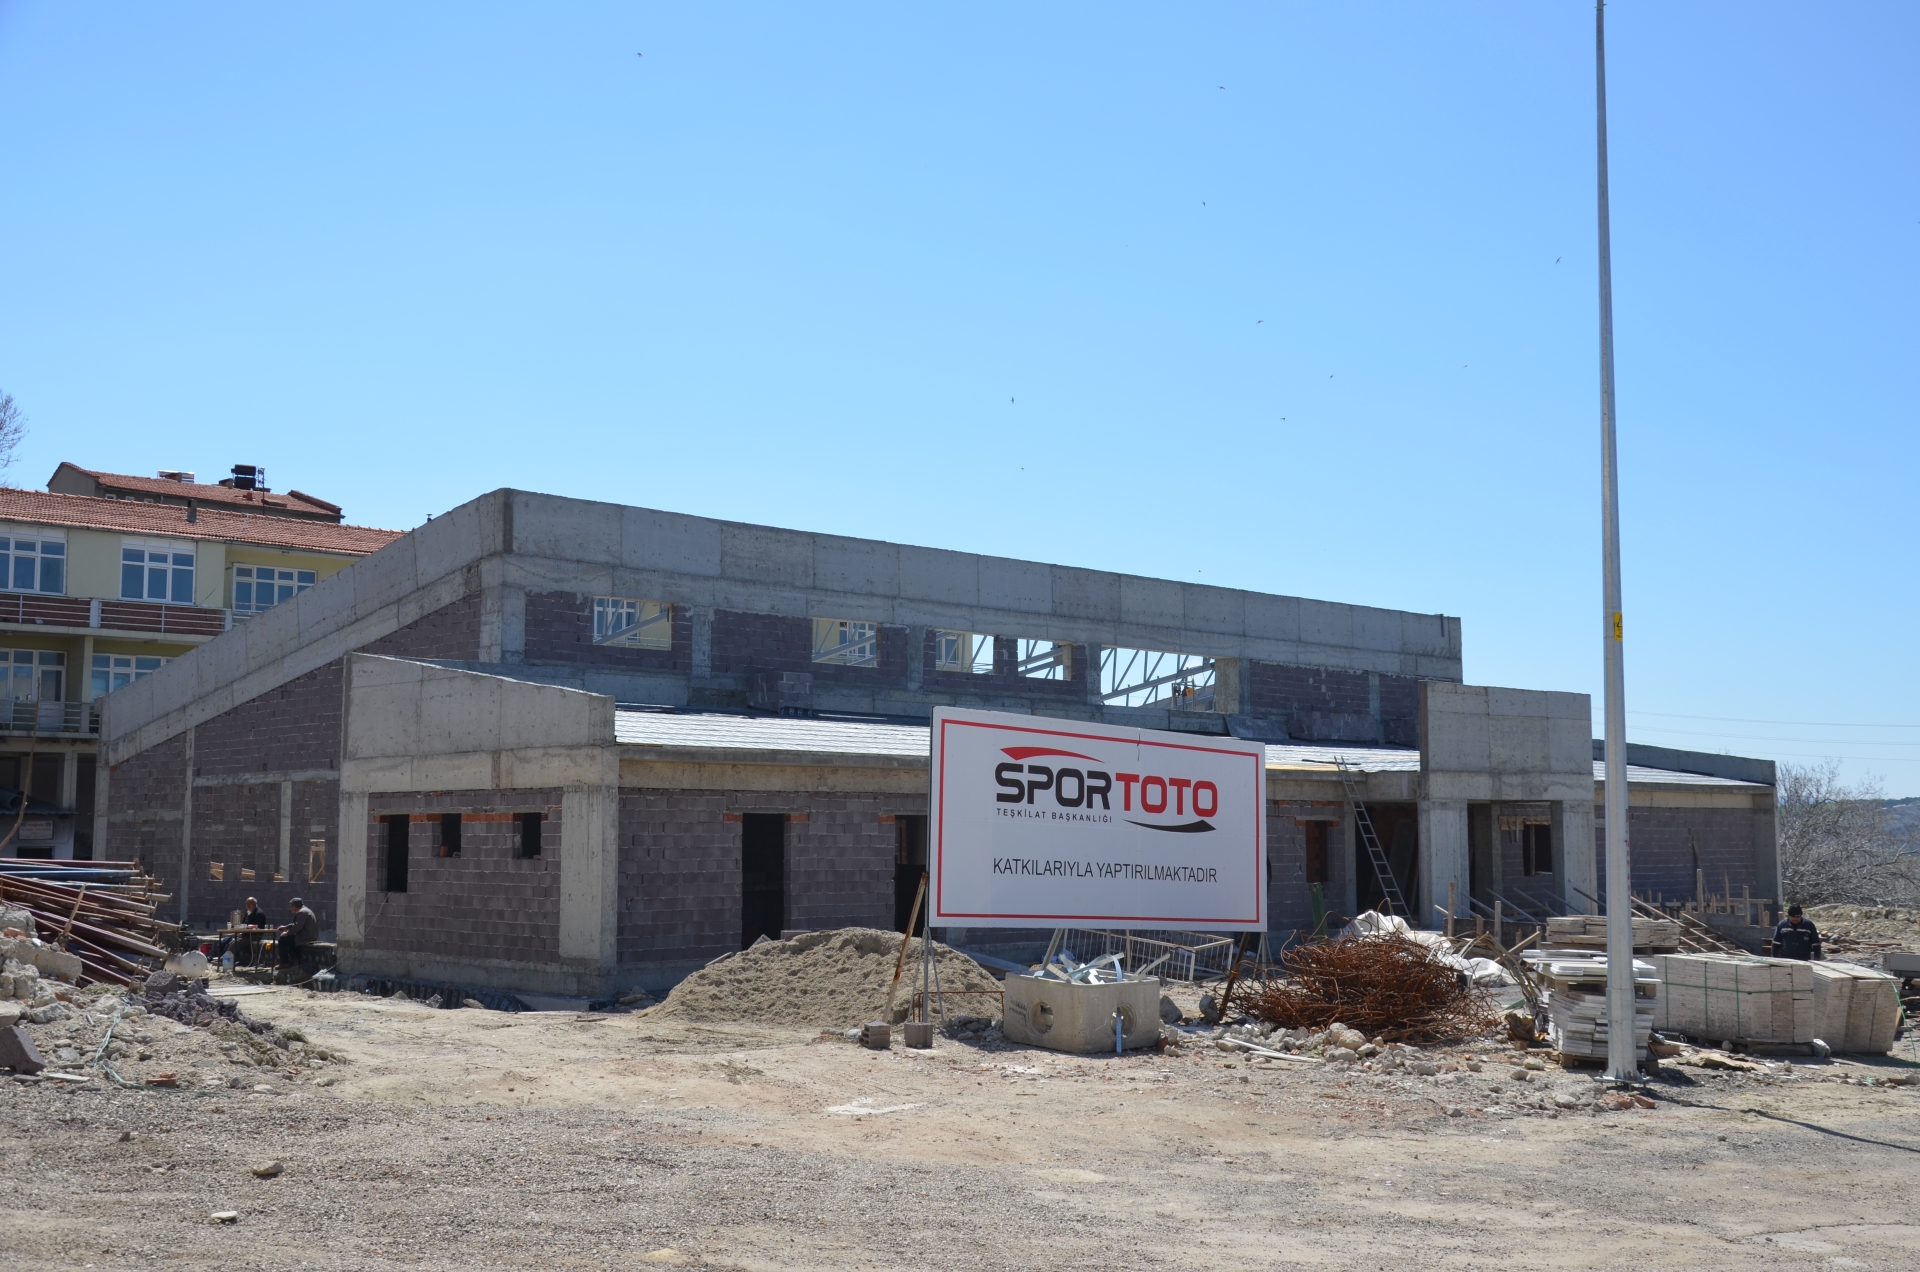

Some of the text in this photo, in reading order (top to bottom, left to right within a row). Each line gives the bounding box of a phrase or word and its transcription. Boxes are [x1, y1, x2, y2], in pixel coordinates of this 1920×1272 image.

[996, 807, 1112, 823] TEŞKİLAT BAŞKANLIĞI
[993, 857, 1218, 883] KATKILARIYLA YAPTIRILMAKTADIR
